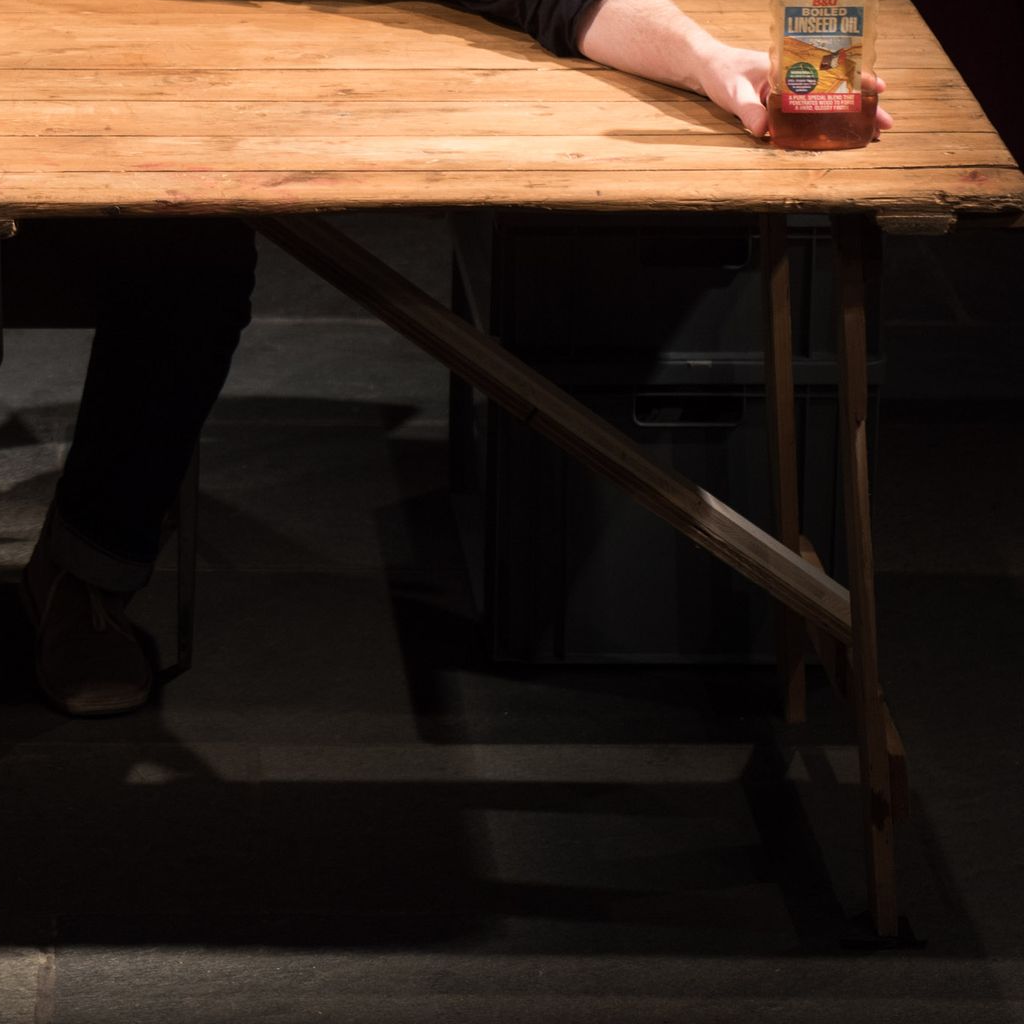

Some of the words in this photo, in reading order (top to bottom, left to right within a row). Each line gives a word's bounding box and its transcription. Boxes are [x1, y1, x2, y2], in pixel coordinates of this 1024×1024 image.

[801, 7, 848, 16] BOILED
[788, 16, 837, 33] LINSEED
[840, 16, 860, 33] OIL
